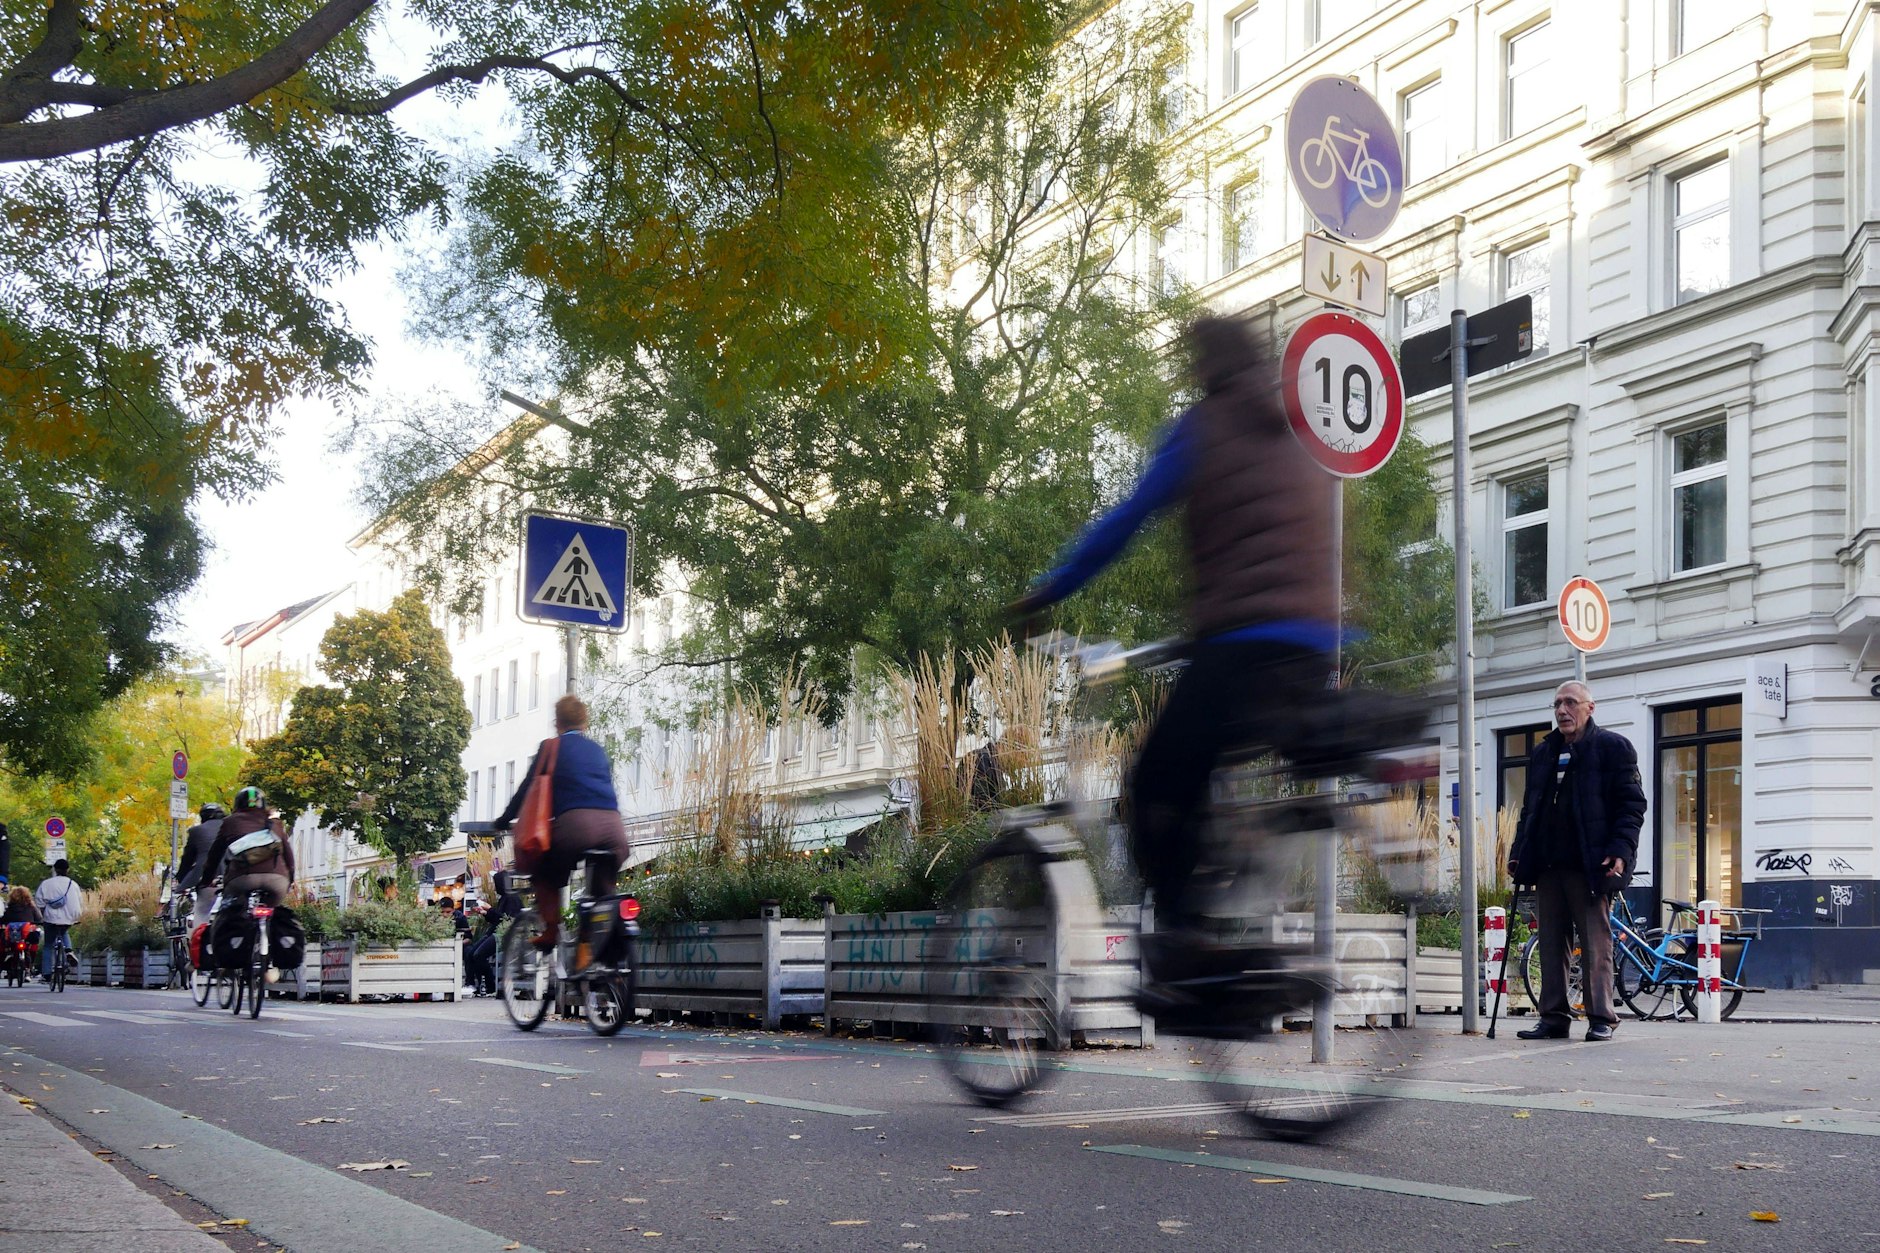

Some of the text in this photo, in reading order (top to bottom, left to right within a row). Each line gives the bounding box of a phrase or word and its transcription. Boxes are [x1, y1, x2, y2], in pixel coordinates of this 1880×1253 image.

[1315, 357, 1372, 434] 10
[1573, 599, 1597, 633] 10
[1757, 675, 1781, 688] ace &
[1764, 689, 1782, 702] tate
